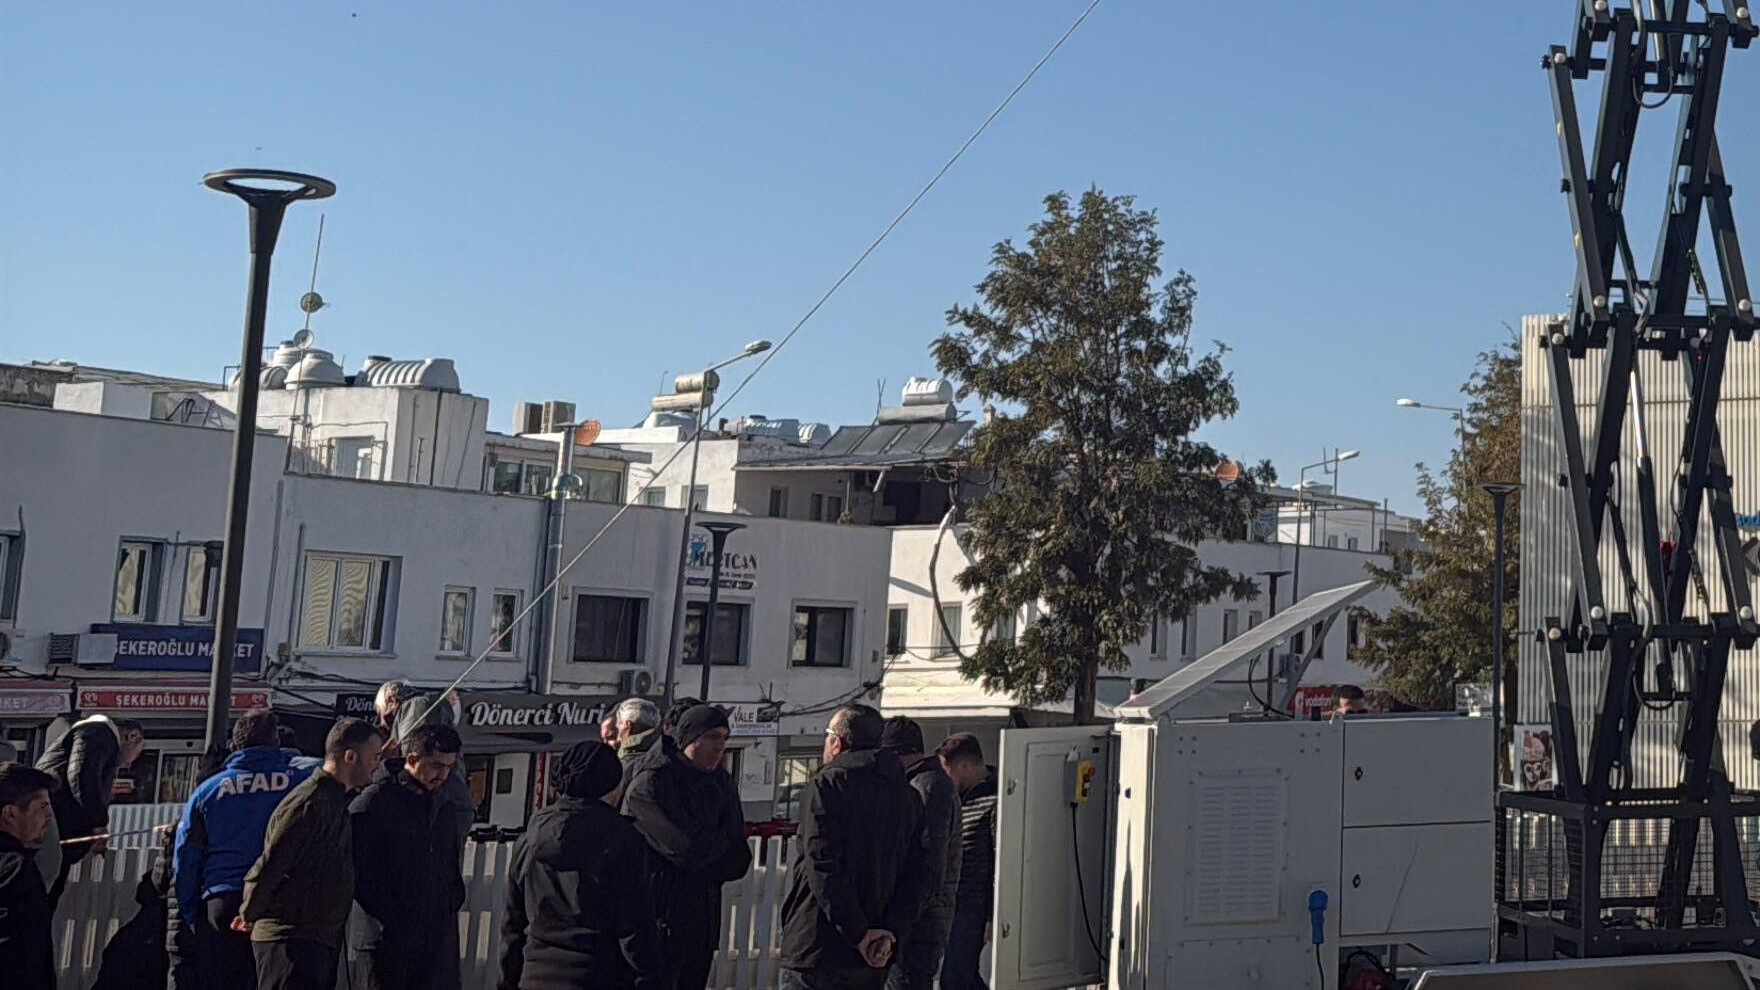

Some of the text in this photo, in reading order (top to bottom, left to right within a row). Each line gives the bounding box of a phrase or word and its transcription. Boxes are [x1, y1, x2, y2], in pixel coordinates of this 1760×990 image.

[198, 642, 255, 658] MAKET
[116, 692, 186, 709] ŞEKEROĞLU
[470, 701, 606, 726] Dönerci Nuri
[216, 771, 289, 801] AFAD
